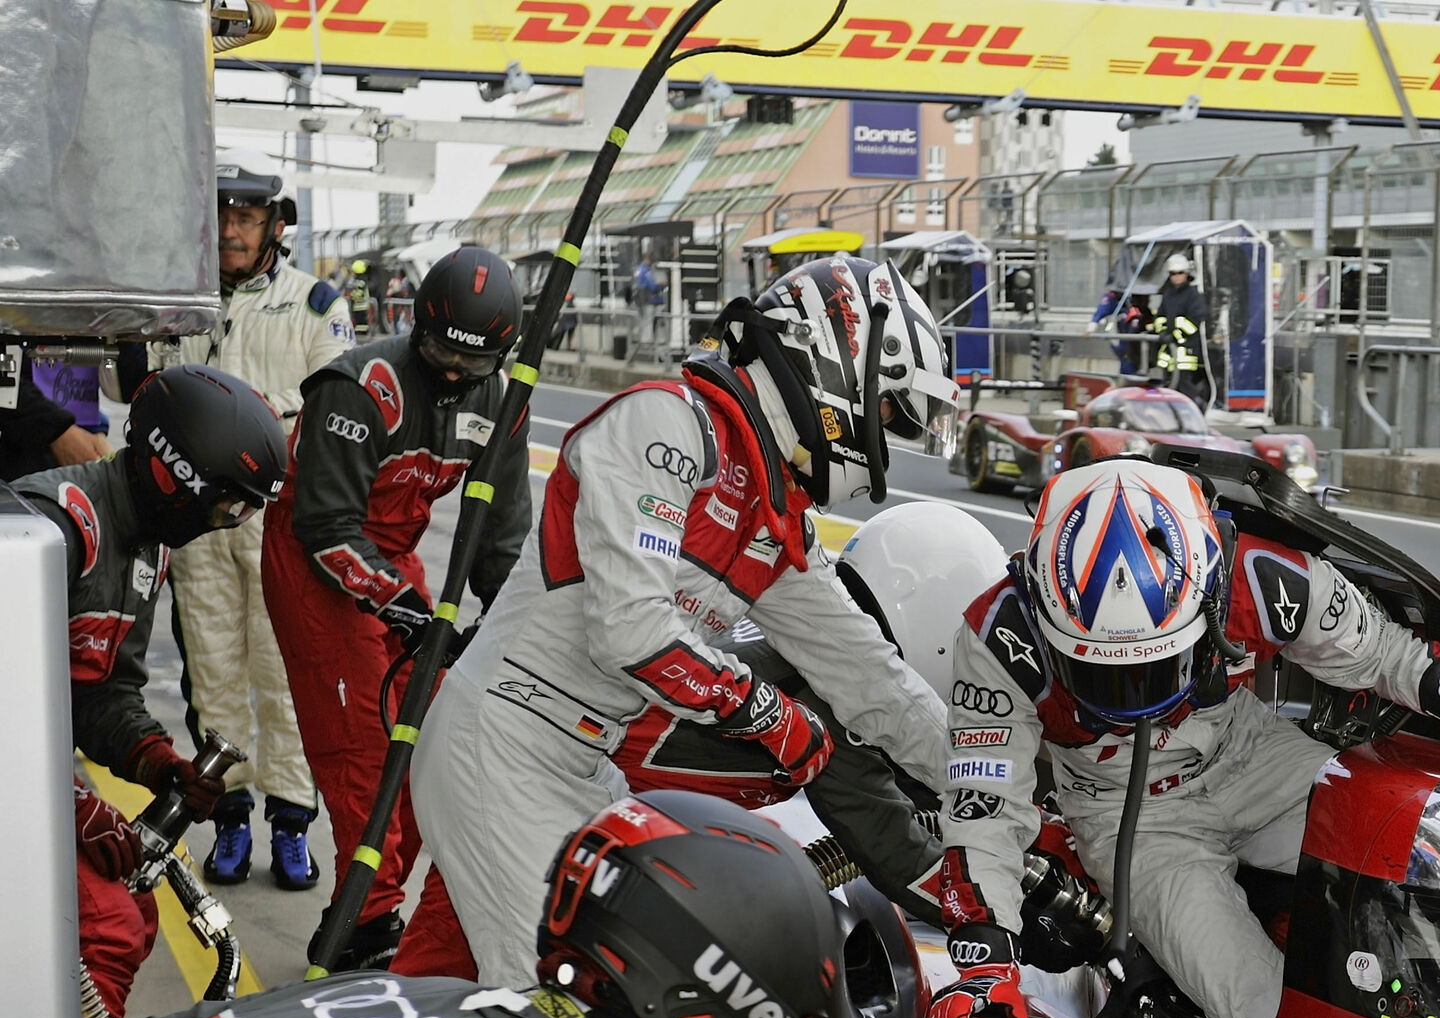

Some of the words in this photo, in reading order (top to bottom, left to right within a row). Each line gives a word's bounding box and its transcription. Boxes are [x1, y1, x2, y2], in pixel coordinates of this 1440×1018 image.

[841, 18, 1036, 67] DHL
[1144, 36, 1325, 85] DHL
[446, 326, 487, 347] uvex
[822, 411, 837, 435] 036
[148, 427, 208, 496] uvex
[639, 531, 679, 560] MAH
[1091, 646, 1129, 658] Audi
[1133, 639, 1177, 657] Sport
[956, 729, 1006, 746] Castrol
